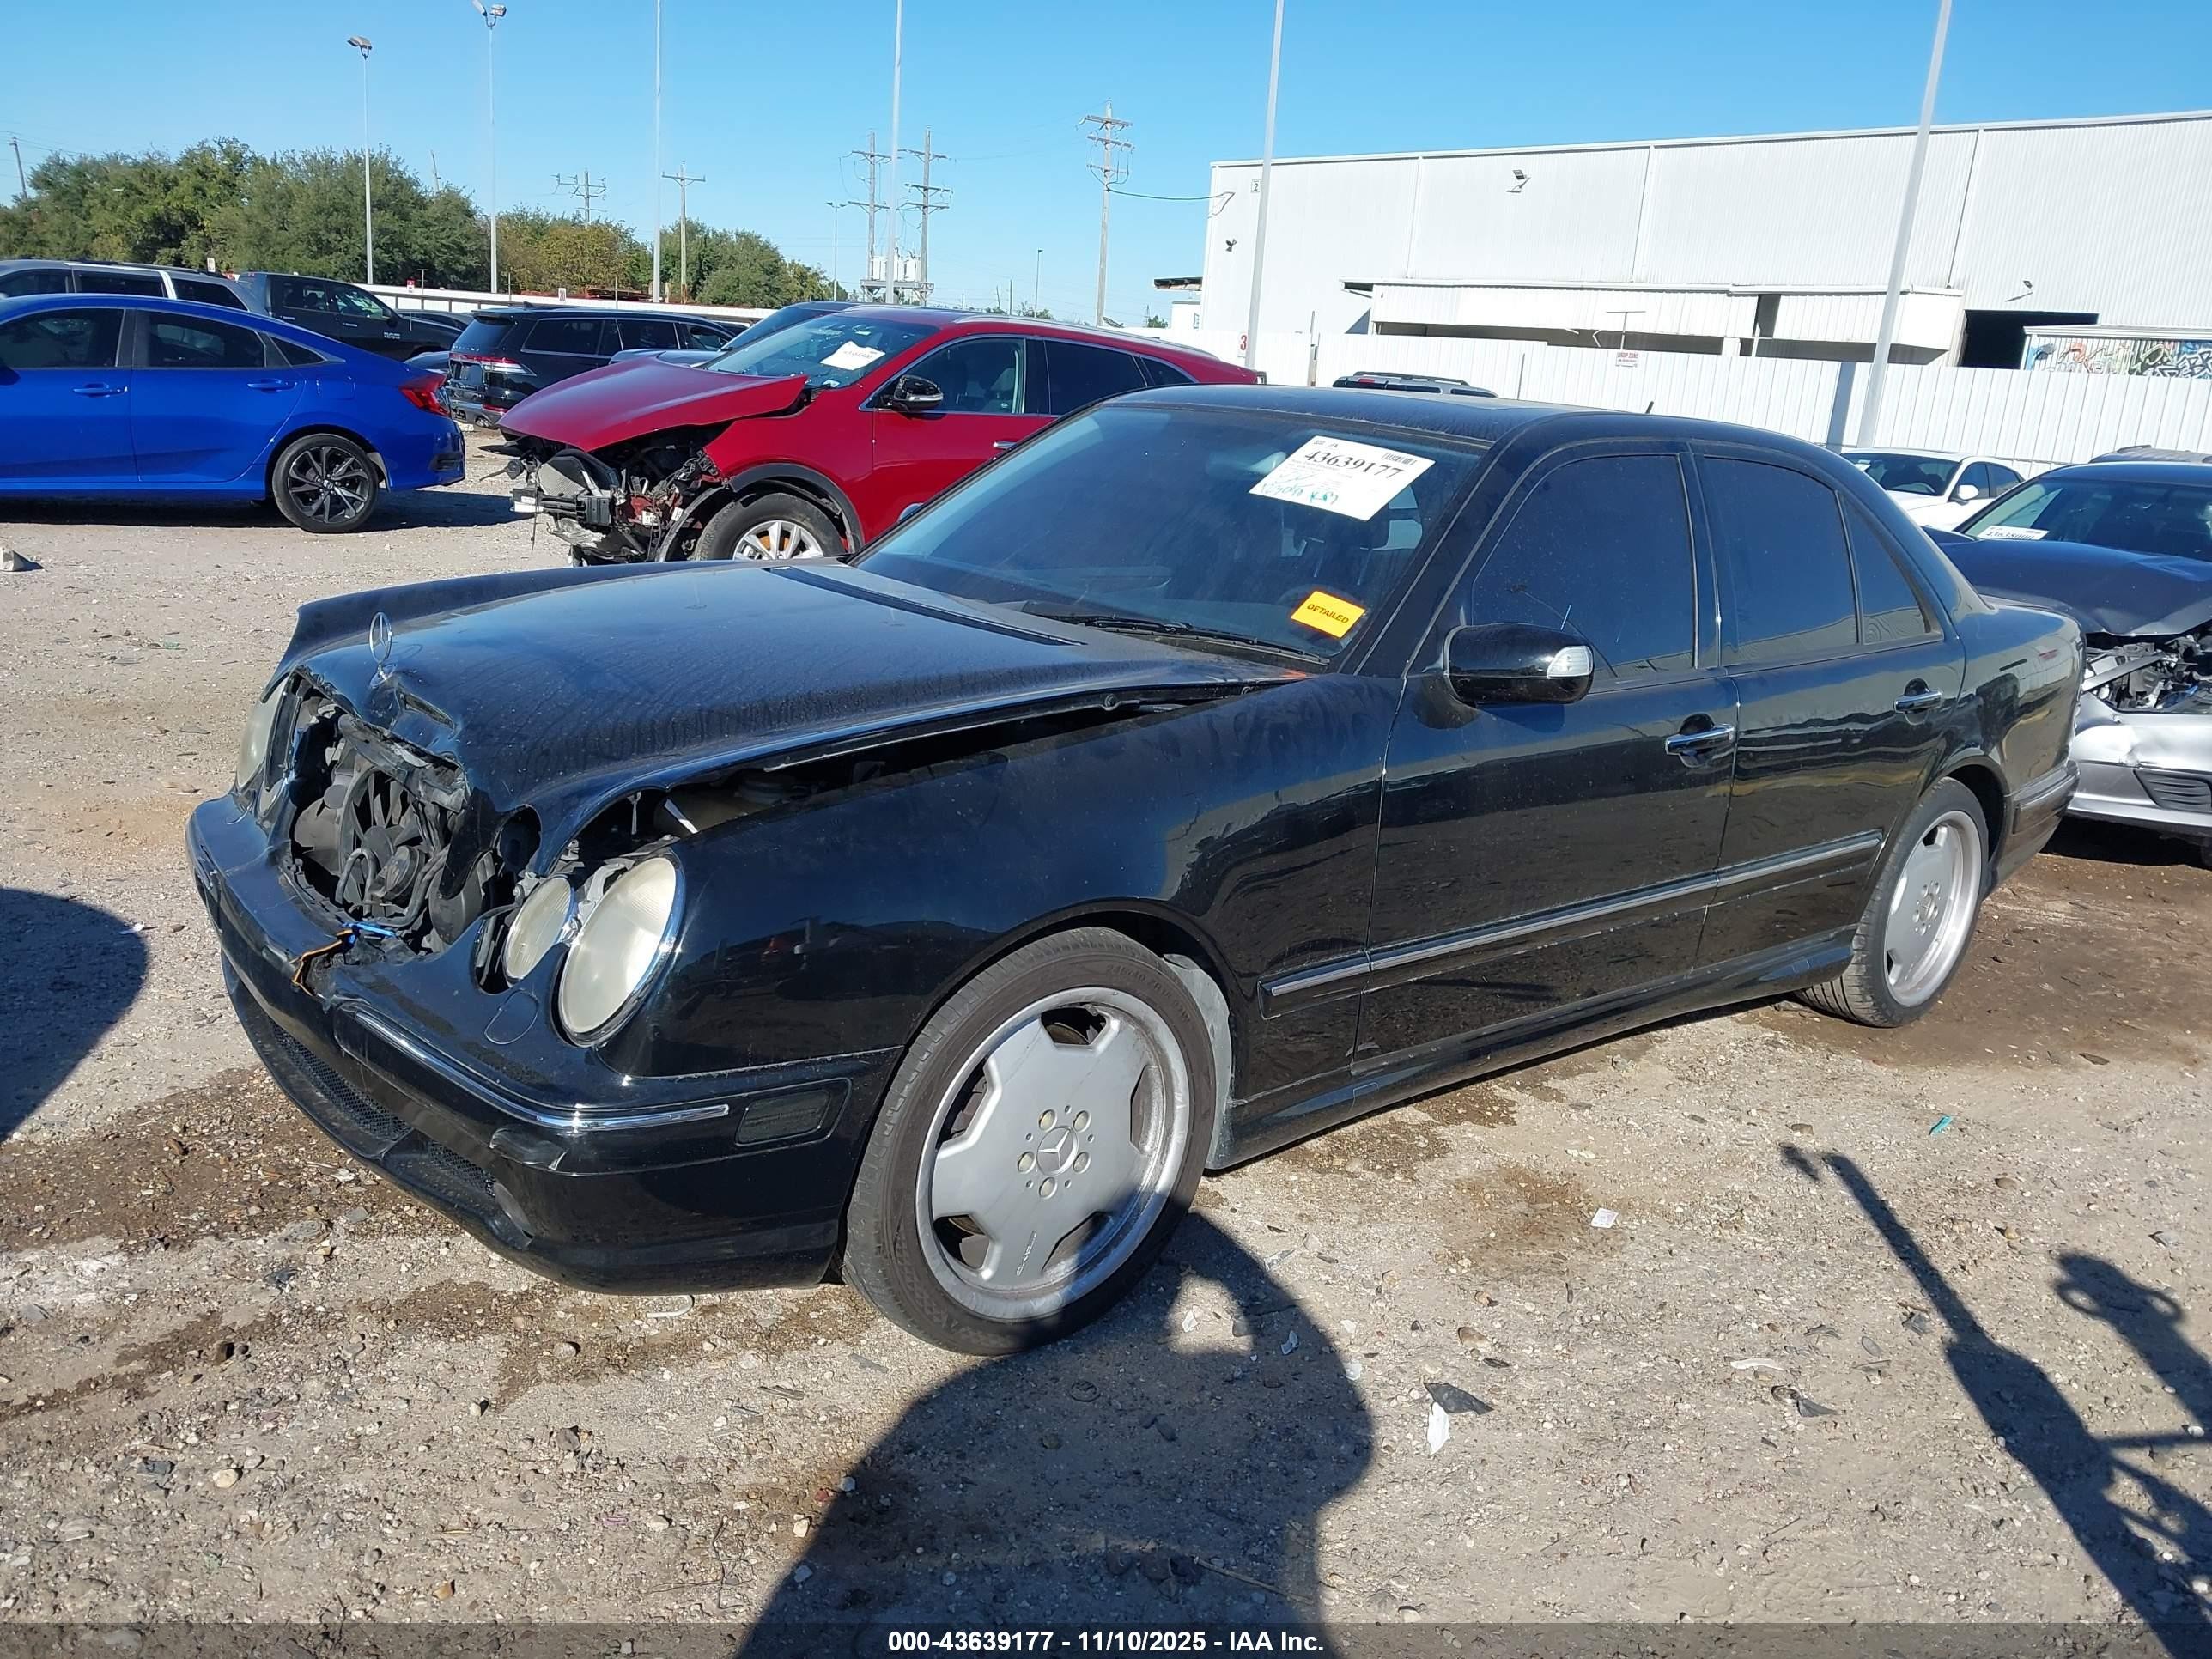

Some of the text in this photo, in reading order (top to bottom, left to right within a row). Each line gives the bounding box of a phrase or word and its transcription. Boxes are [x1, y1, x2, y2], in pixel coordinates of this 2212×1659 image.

[1240, 335, 1247, 350] 3
[1304, 451, 1404, 478] 43639177
[1306, 604, 1349, 623] DETAILED
